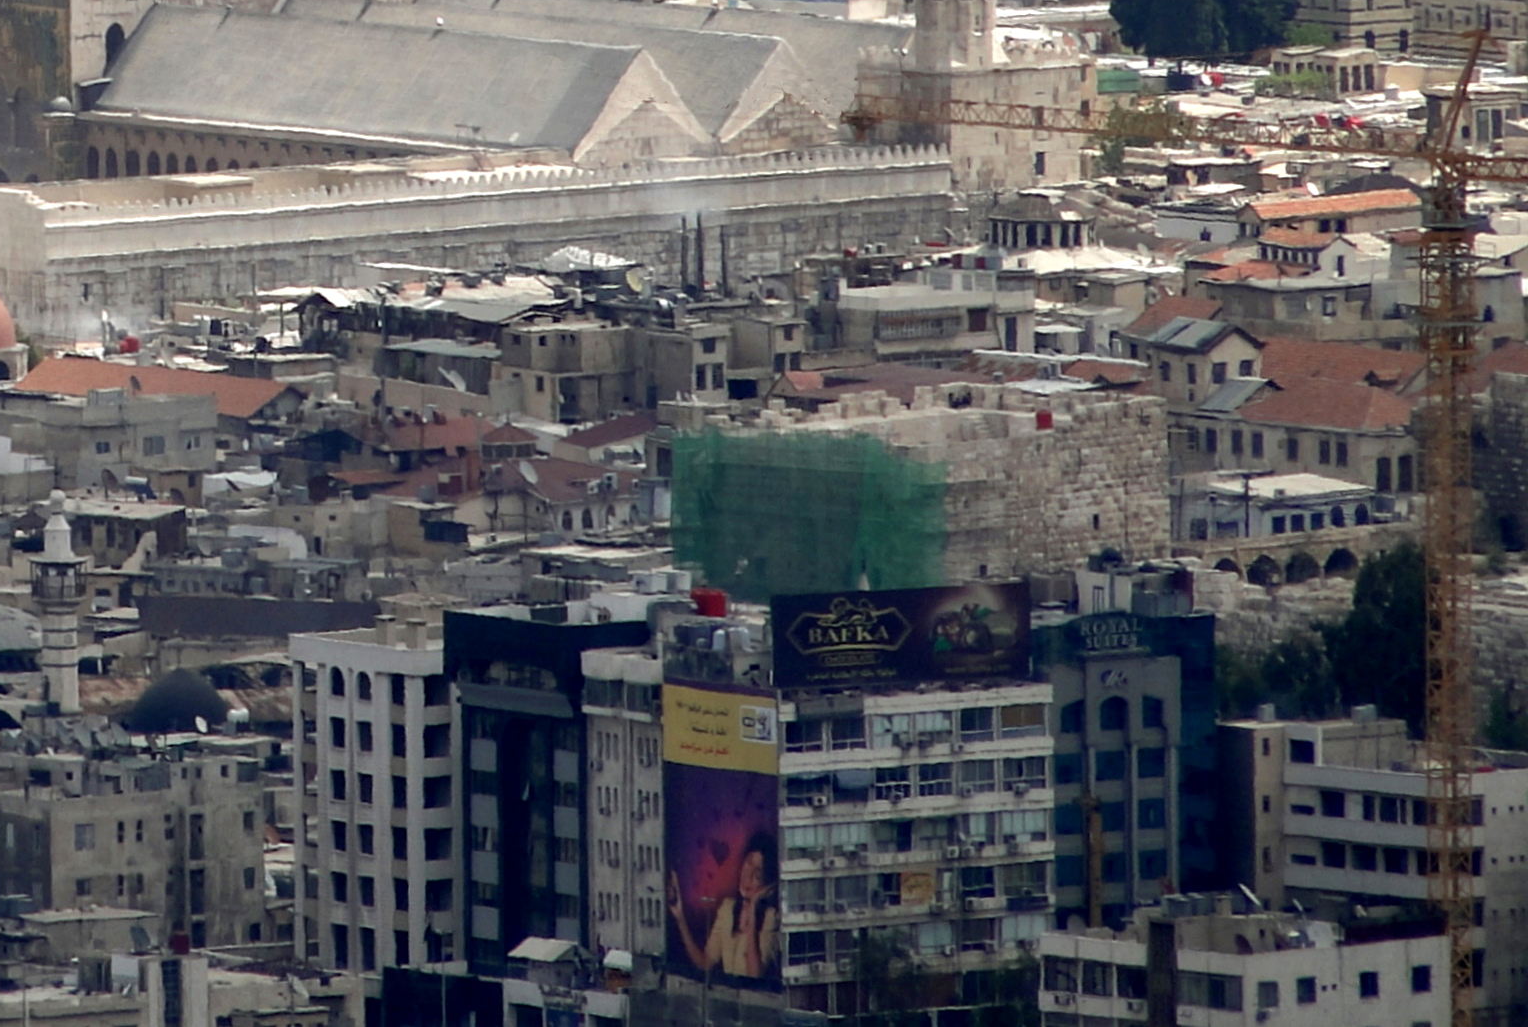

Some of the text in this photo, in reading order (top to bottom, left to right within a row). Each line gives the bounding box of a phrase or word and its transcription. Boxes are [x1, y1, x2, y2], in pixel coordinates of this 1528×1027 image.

[807, 626, 890, 644] BAFKA
[1080, 618, 1144, 636] ROYAL
[1085, 634, 1138, 649] SUITES
